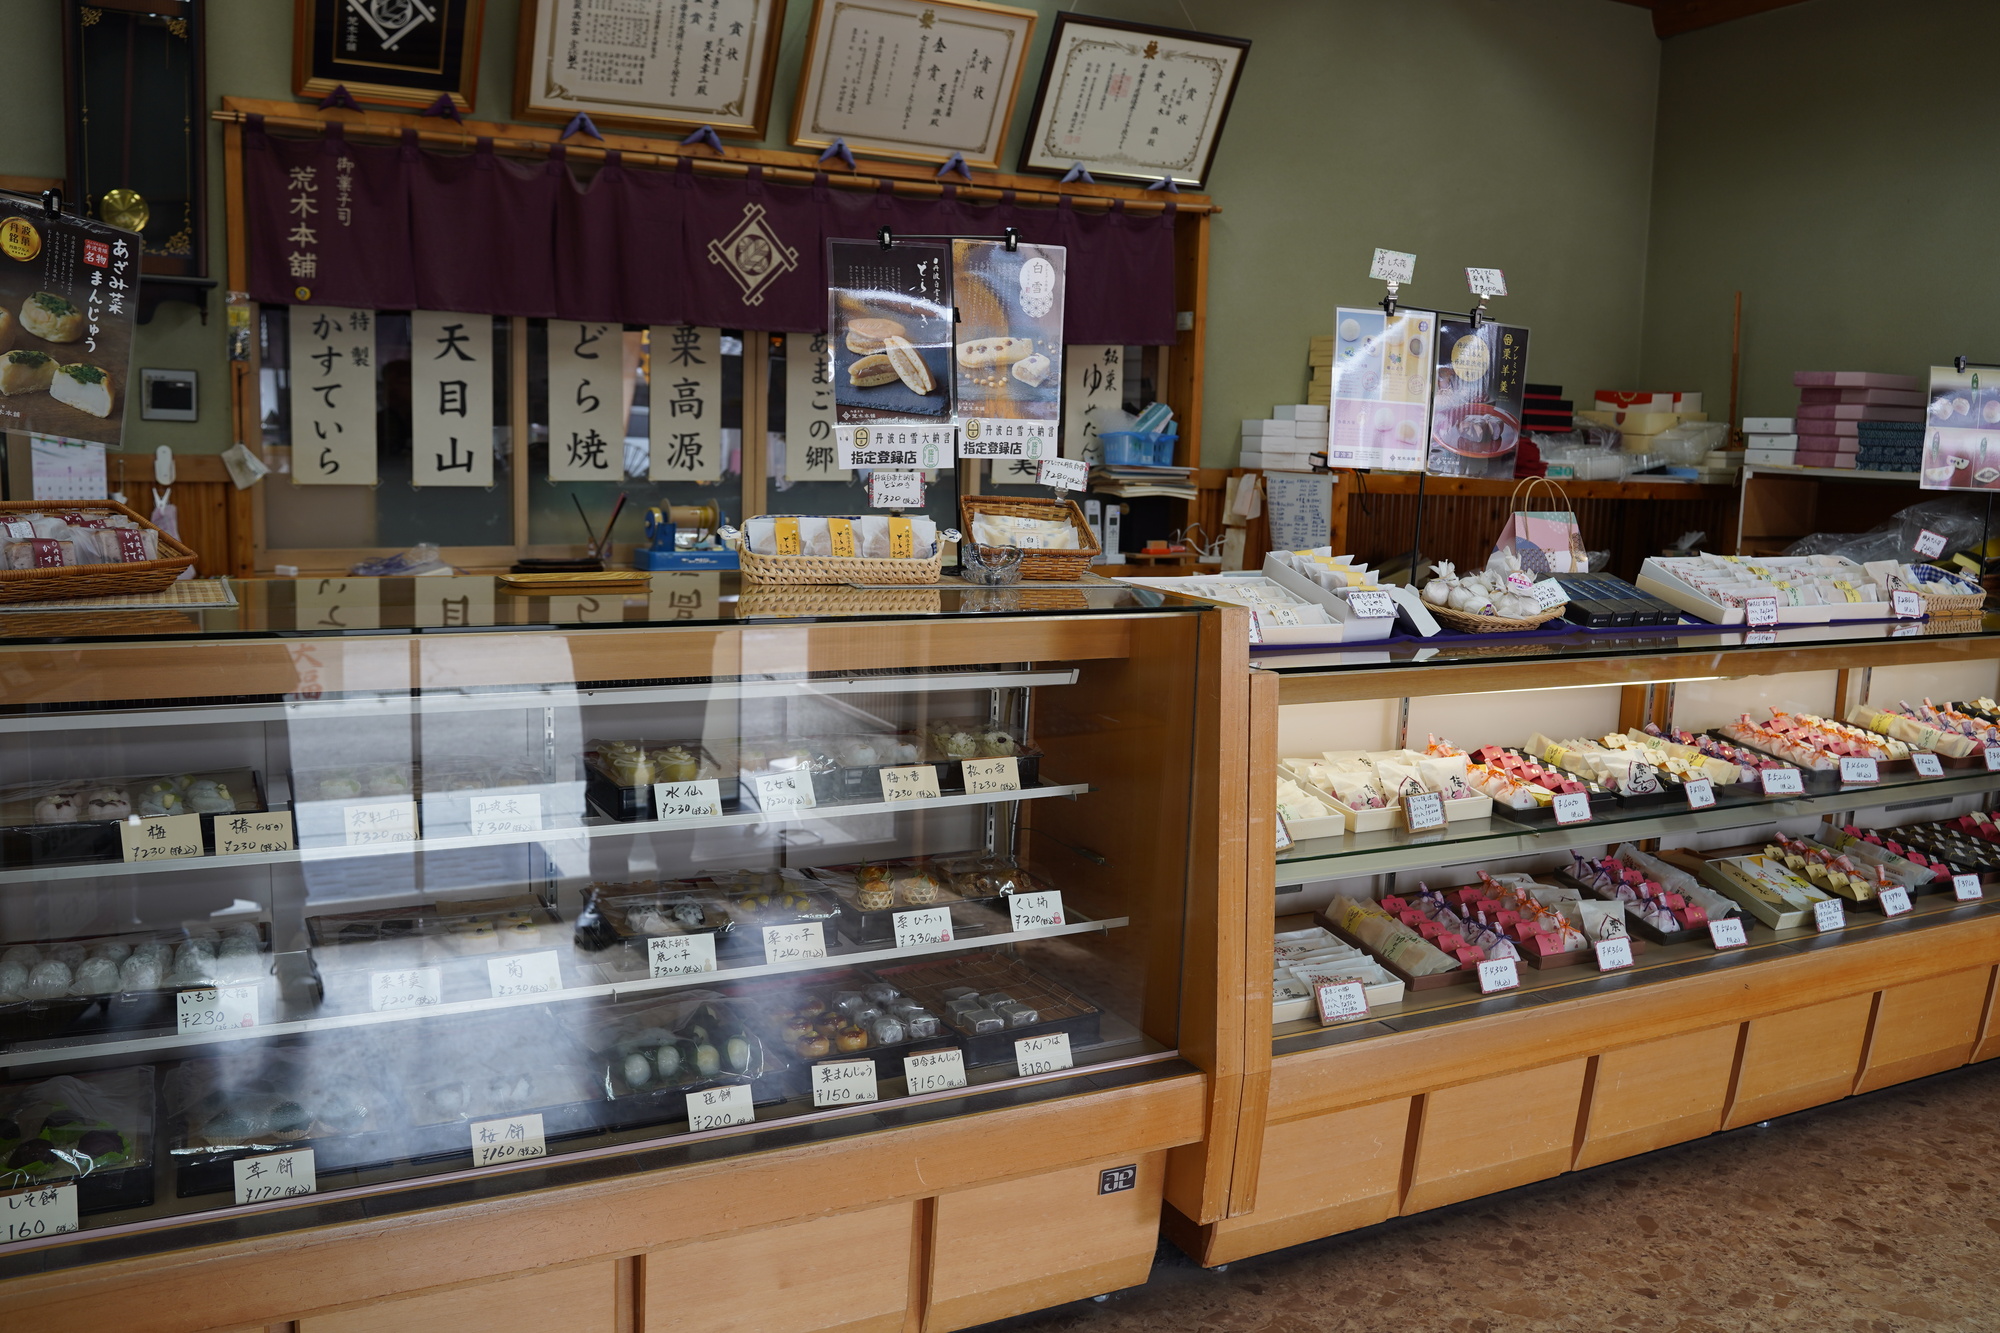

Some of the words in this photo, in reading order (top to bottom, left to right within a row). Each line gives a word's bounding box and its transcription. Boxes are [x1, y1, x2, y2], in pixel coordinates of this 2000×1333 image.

[336, 157, 355, 227] 御菓子司
[287, 166, 319, 278] 荒木本舗
[86, 251, 107, 265] 名物
[108, 238, 129, 315] あざみ菜
[1032, 262, 1043, 293] 白雪
[85, 270, 103, 353] まんじゅう
[350, 311, 371, 367] 特製
[1102, 347, 1119, 391] 銘菓
[1499, 348, 1511, 393] 栗羊羹
[1511, 345, 1519, 385] プレミアム
[312, 313, 343, 475] かすていら
[434, 324, 476, 473] 天目山
[566, 324, 608, 470] どら焼
[667, 325, 706, 471] 栗高原
[876, 432, 951, 445] 丹波白雪大納言
[985, 424, 1054, 438] 丹波白雪大納言
[963, 441, 1022, 455] 指定登録店
[851, 450, 917, 465] 指定登録店
[876, 493, 901, 504] ¥320
[665, 785, 703, 799] 水仙
[888, 788, 913, 801] ¥230
[971, 781, 997, 794] ¥230
[475, 799, 522, 816] 丹波栗
[662, 802, 690, 818] ¥230
[147, 824, 167, 839] 梅
[228, 818, 251, 834] 椿
[475, 822, 510, 836] ¥300
[352, 831, 389, 845] ¥320
[131, 846, 166, 862] ¥230
[170, 845, 198, 857] (税込)
[222, 841, 256, 856] ¥230
[258, 841, 286, 853] (税込)
[1015, 914, 1041, 930] ¥300
[899, 932, 931, 947] ¥330
[654, 966, 681, 978] ¥300
[378, 972, 424, 990] 栗羊羹
[181, 989, 248, 1005] いちご大福
[380, 994, 414, 1010] ¥200
[181, 1011, 224, 1028] ¥280
[1023, 1035, 1063, 1053] きんつば
[911, 1052, 961, 1068] 田舎まんじゅう
[1021, 1060, 1052, 1075] ¥180
[821, 1066, 873, 1084] 栗まんじゅう
[910, 1075, 946, 1092] ¥150
[816, 1089, 850, 1103] ¥150
[693, 1114, 732, 1130] ¥200
[479, 1123, 525, 1144] 桜餅
[482, 1145, 515, 1165] ¥160
[517, 1145, 543, 1157] (税込)
[245, 1157, 293, 1181] 草餅
[8, 1189, 59, 1209] しそ餅
[246, 1186, 281, 1203] ¥170
[284, 1184, 311, 1196] (税込)
